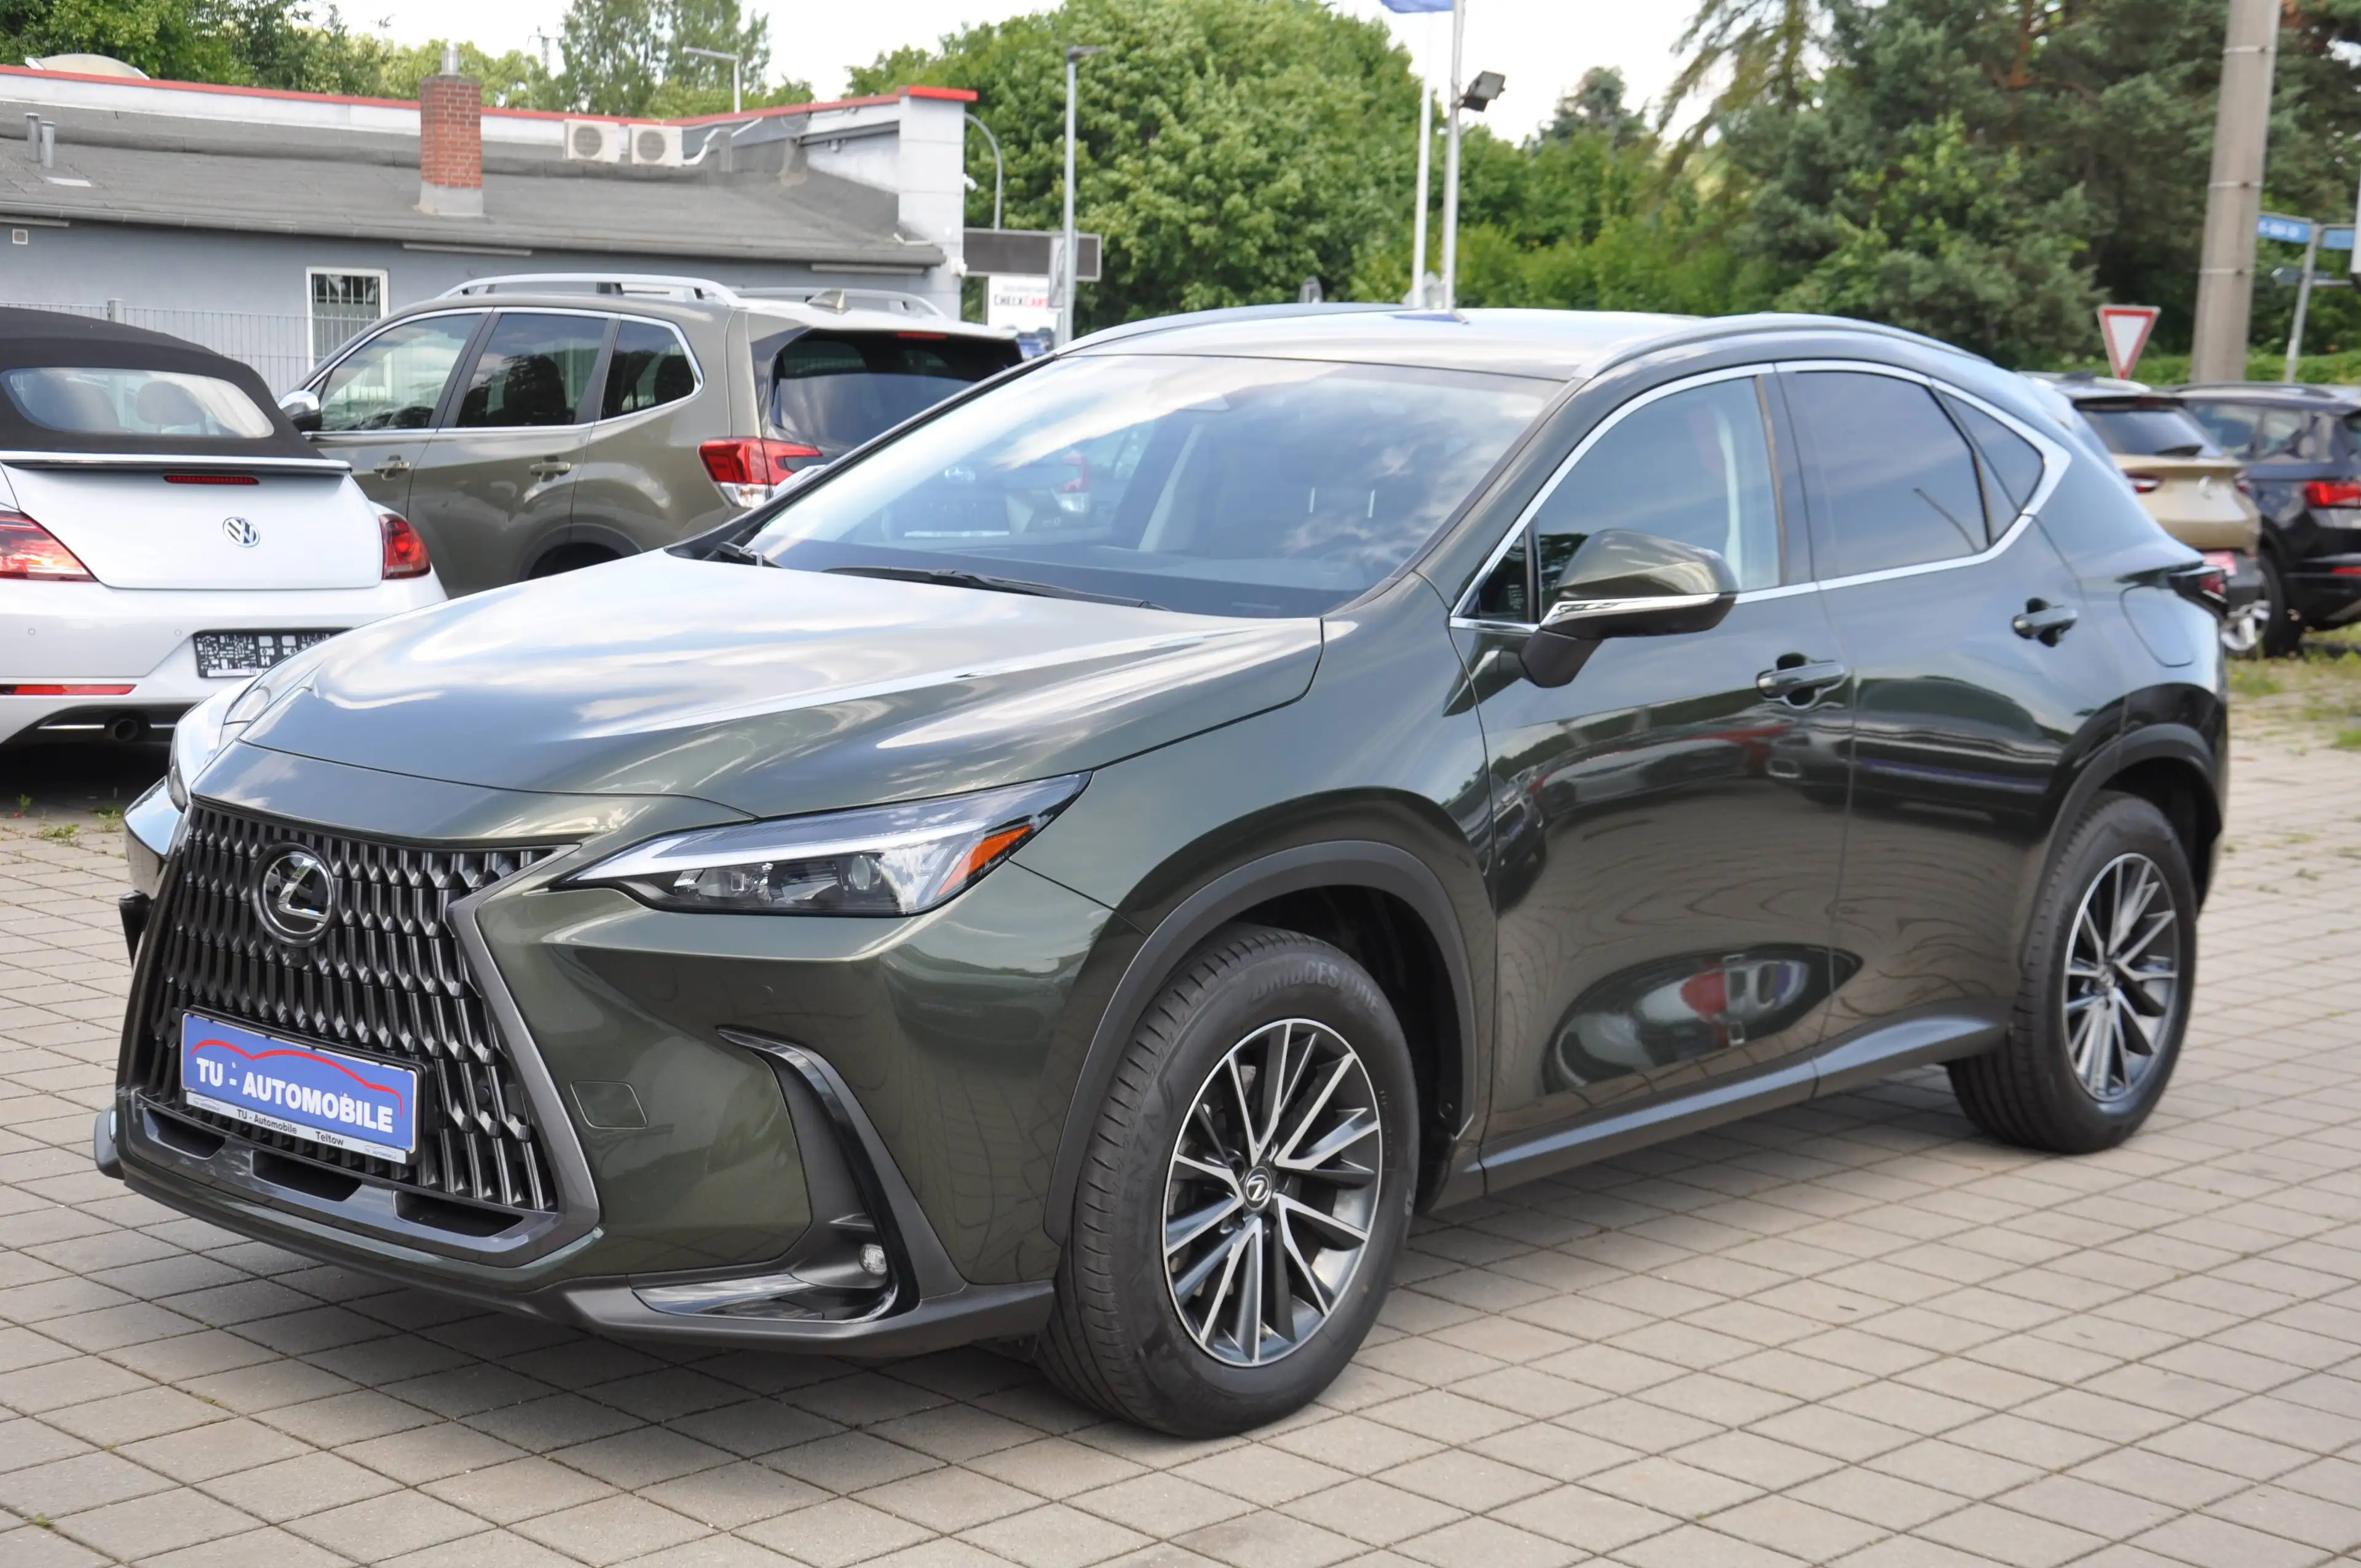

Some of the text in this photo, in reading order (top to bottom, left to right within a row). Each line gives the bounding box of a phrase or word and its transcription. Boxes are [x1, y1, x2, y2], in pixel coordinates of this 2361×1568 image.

[196, 1056, 223, 1087] TU
[242, 1071, 393, 1133] AUTOMOBILE
[237, 1109, 247, 1119] TU
[254, 1114, 298, 1134] Automobile
[315, 1131, 344, 1146] Teltow
